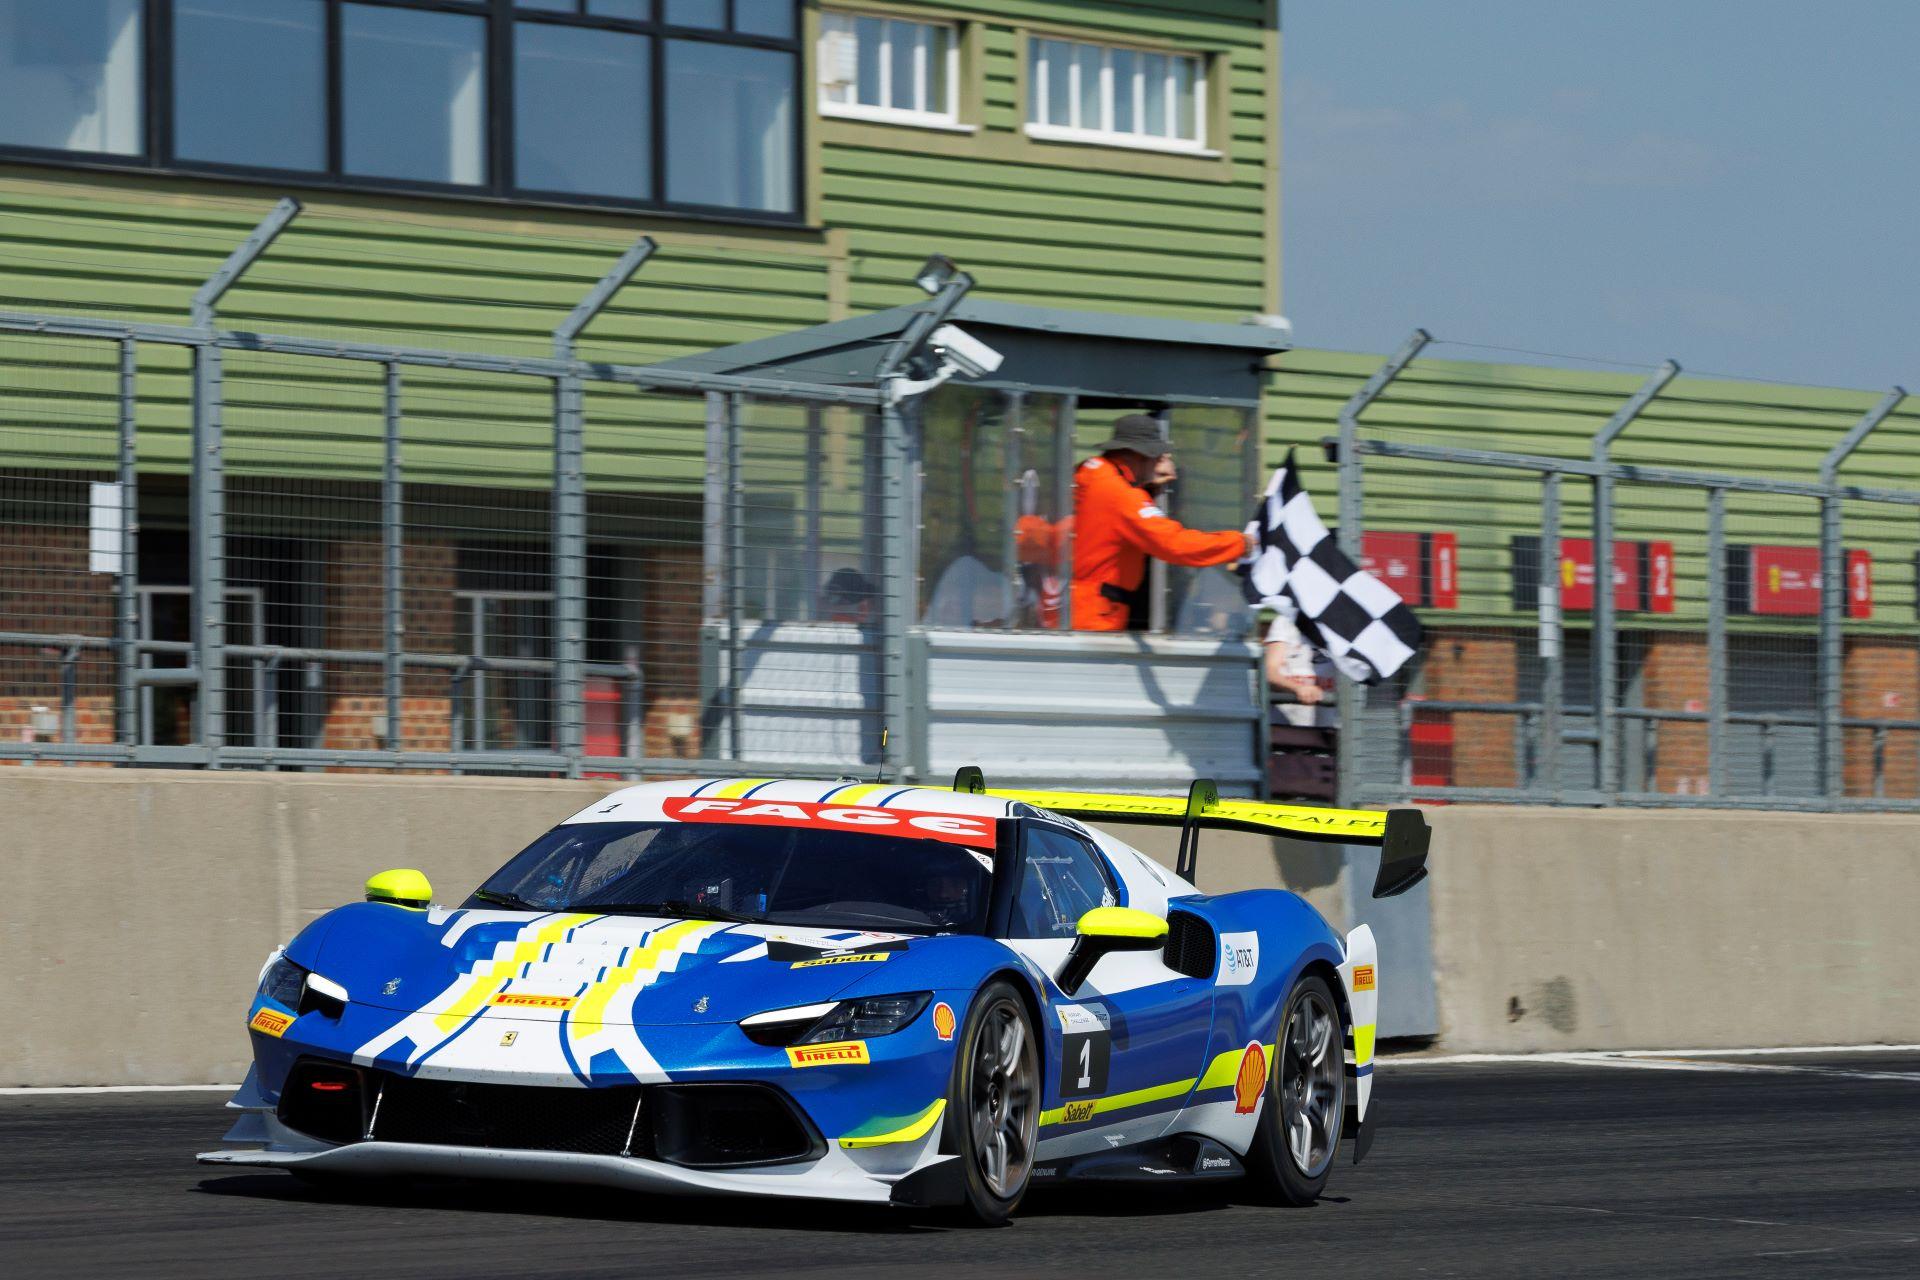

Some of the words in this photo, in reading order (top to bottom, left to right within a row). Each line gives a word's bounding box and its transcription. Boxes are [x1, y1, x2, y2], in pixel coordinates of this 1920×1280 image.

[1654, 555, 1669, 596] 2
[677, 799, 990, 837] FAGE
[1081, 802, 1237, 816] FERRRI
[1235, 948, 1255, 968] AT&T
[1354, 968, 1374, 986] PIRELLI
[495, 994, 572, 1008] PIRELLI
[254, 1010, 290, 1033] PIRELLI
[794, 1044, 862, 1062] PIRELLI
[1077, 1038, 1091, 1089] 1
[1063, 1102, 1094, 1123] Sabelt
